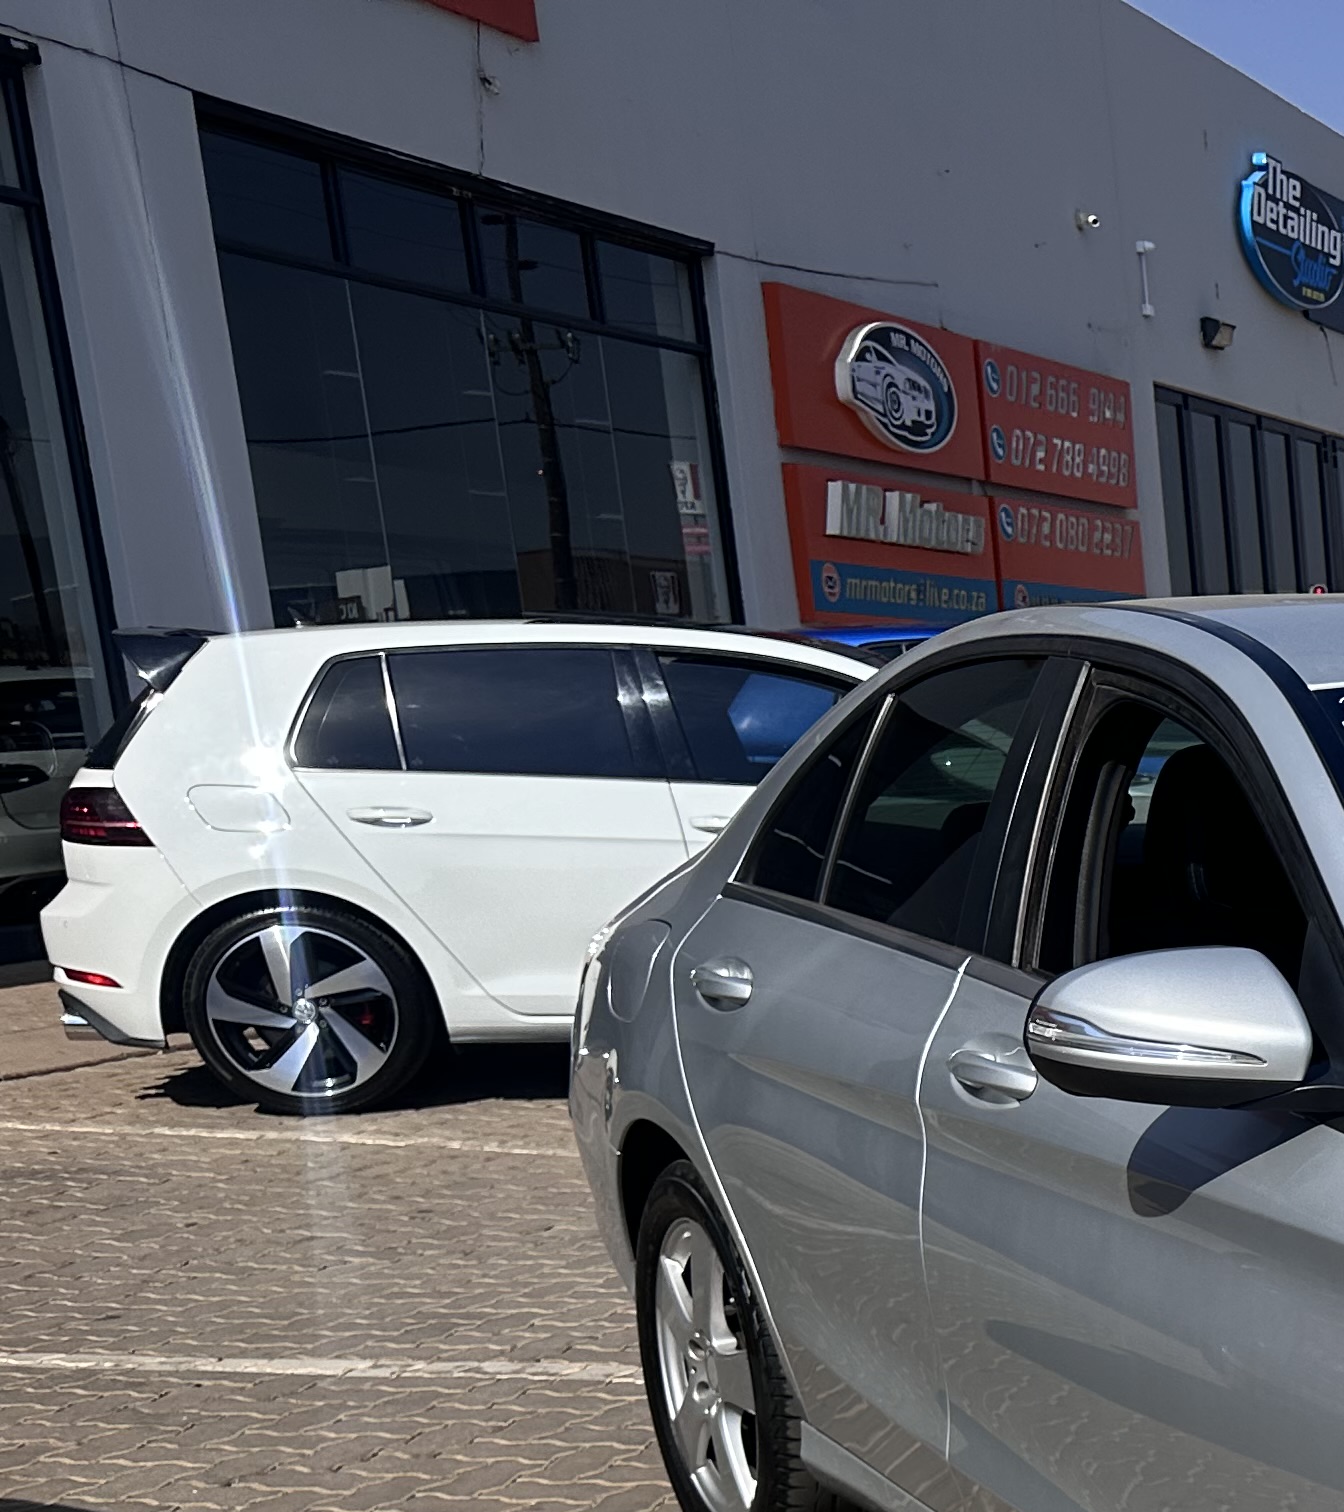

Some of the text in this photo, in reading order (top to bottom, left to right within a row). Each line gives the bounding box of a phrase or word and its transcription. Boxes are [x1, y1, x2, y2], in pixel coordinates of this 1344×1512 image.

[1266, 155, 1302, 207] The
[1252, 184, 1342, 267] Detailing
[1006, 364, 1042, 409] 012
[1046, 375, 1080, 418] 666
[1011, 428, 1047, 472] 072
[1052, 437, 1085, 478] 788
[1017, 506, 1135, 560] 072 080 2237
